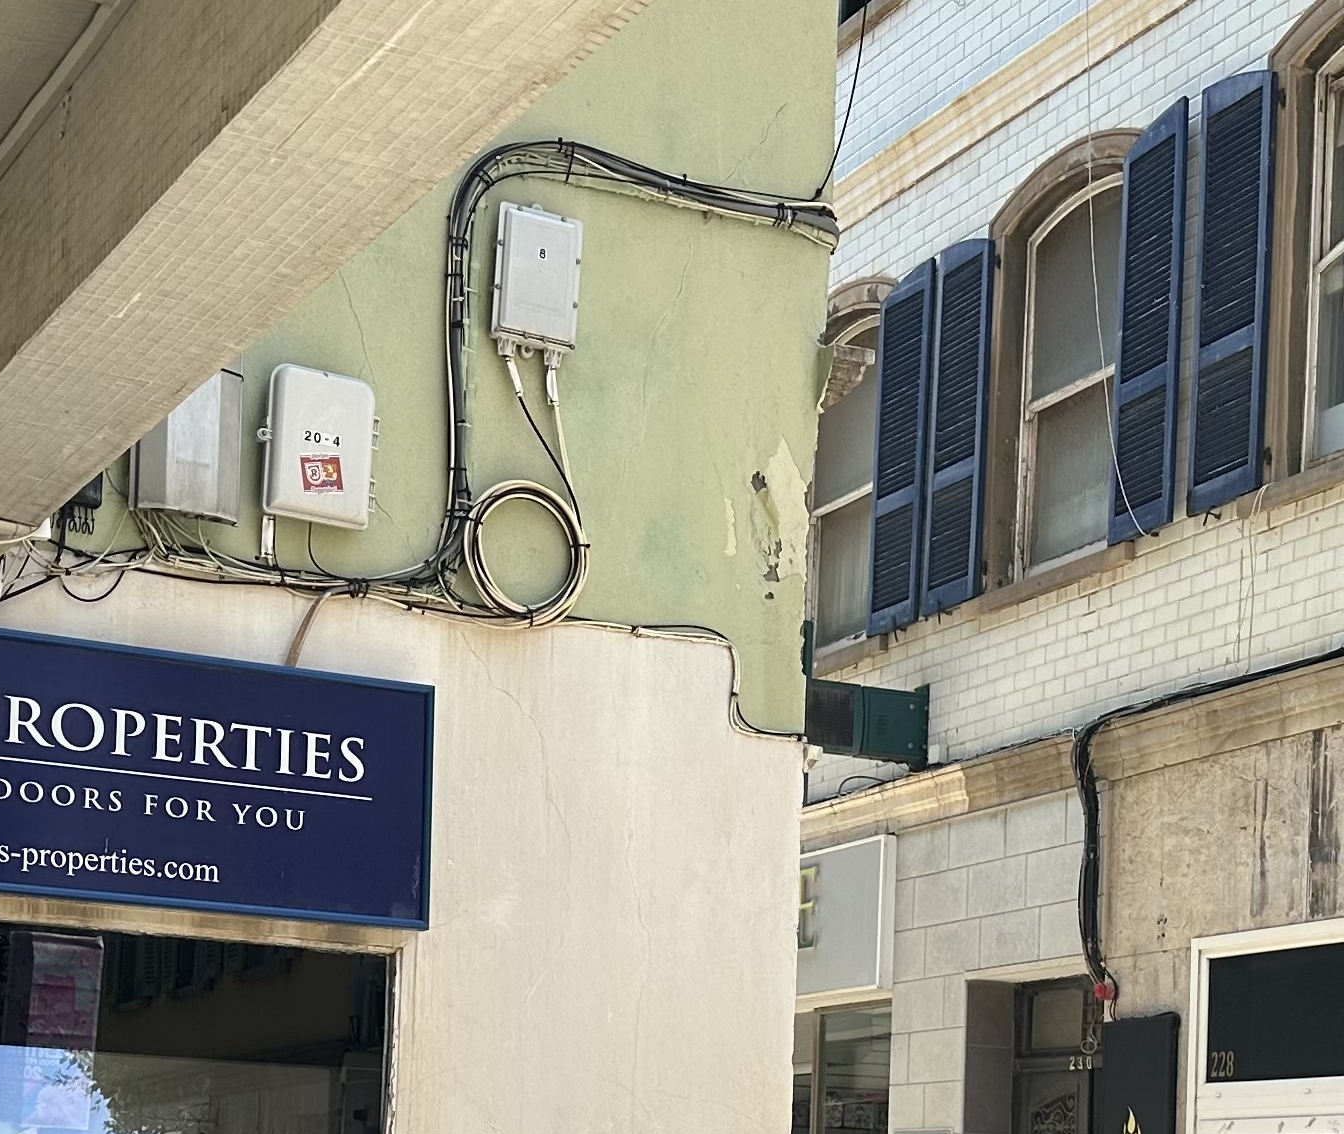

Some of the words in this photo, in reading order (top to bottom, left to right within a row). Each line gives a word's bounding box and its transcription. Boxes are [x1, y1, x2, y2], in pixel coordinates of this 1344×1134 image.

[144, 793, 214, 822] FOR
[230, 801, 307, 831] YOU
[1069, 1056, 1092, 1070] 230
[1210, 1051, 1234, 1077] 228
